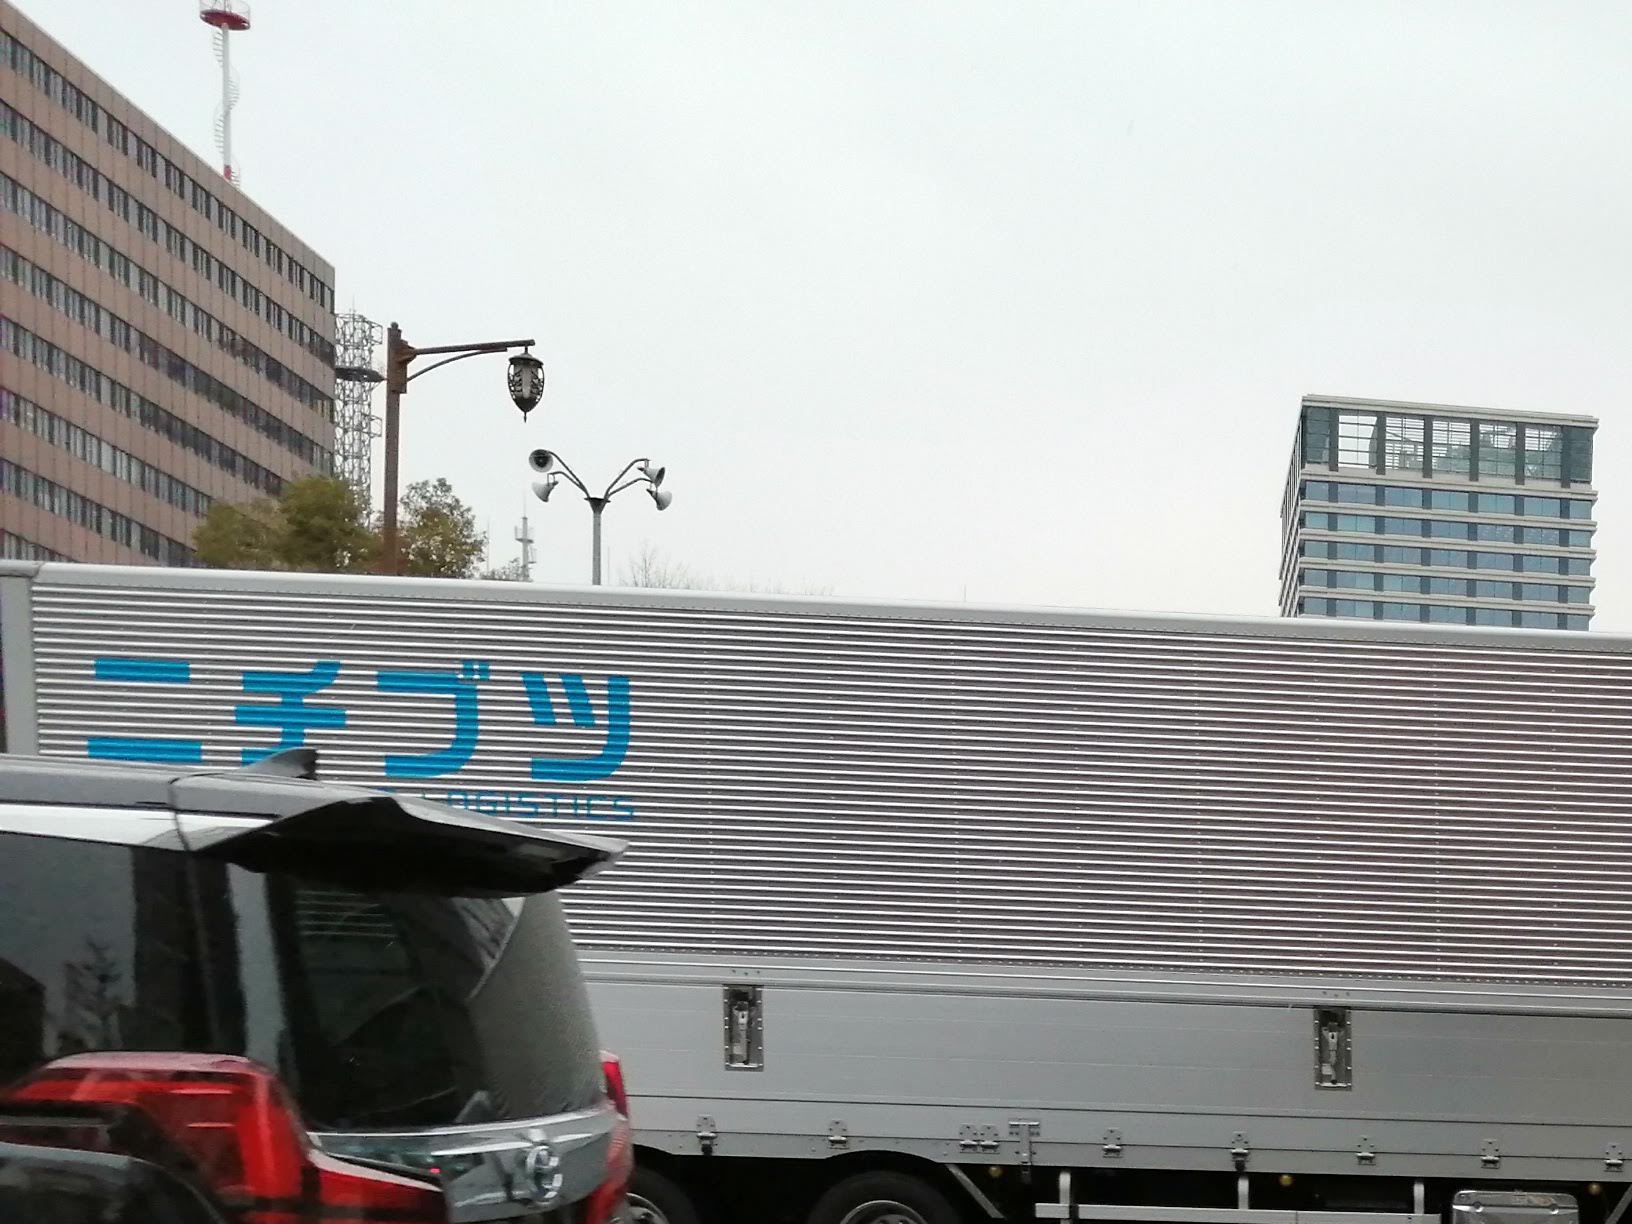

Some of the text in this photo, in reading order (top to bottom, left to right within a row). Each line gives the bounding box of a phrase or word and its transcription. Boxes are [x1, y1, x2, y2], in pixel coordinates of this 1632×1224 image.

[88, 659, 631, 781] ニチブツ
[420, 790, 635, 820] OGISTICS
